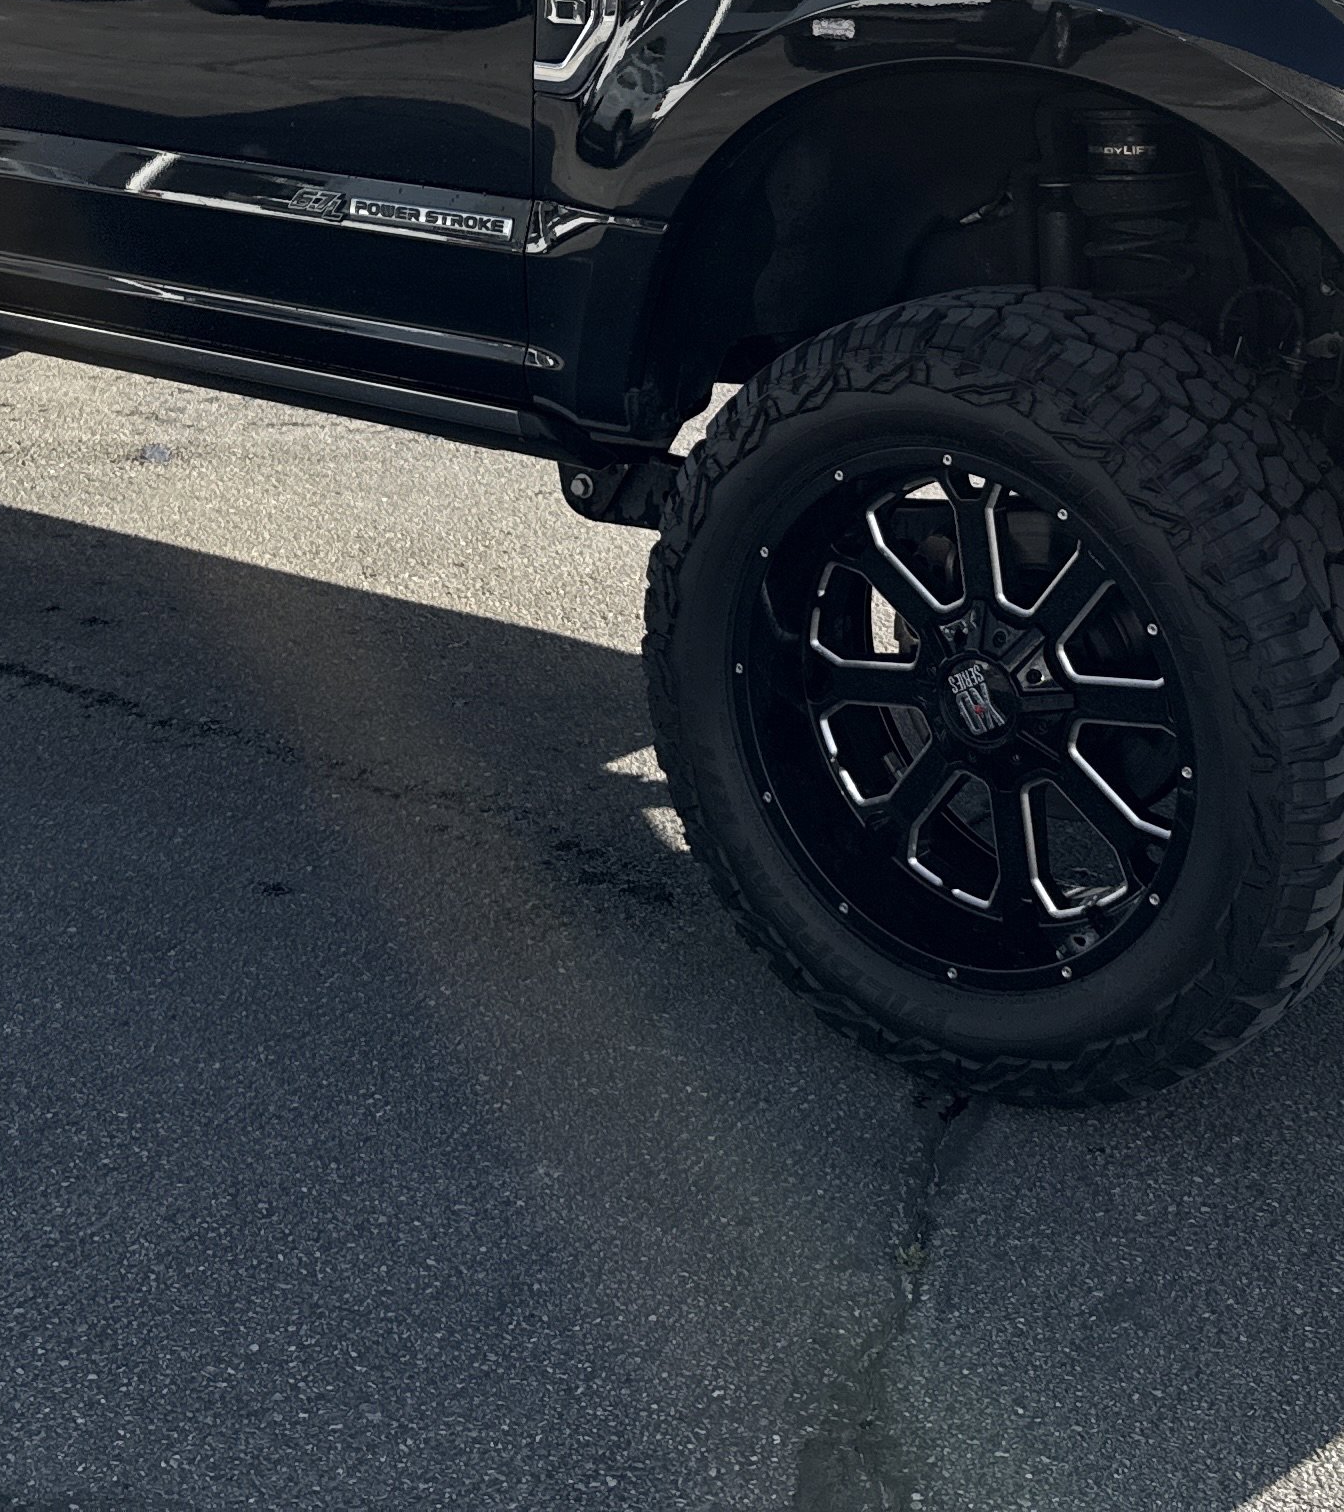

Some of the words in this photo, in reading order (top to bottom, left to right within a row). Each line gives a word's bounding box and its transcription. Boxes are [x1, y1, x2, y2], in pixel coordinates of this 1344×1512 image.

[288, 188, 346, 222] 6.7L
[354, 200, 420, 222] POWER
[425, 210, 505, 232] STROKE
[947, 663, 985, 695] SERIES
[955, 681, 1008, 736] XD
